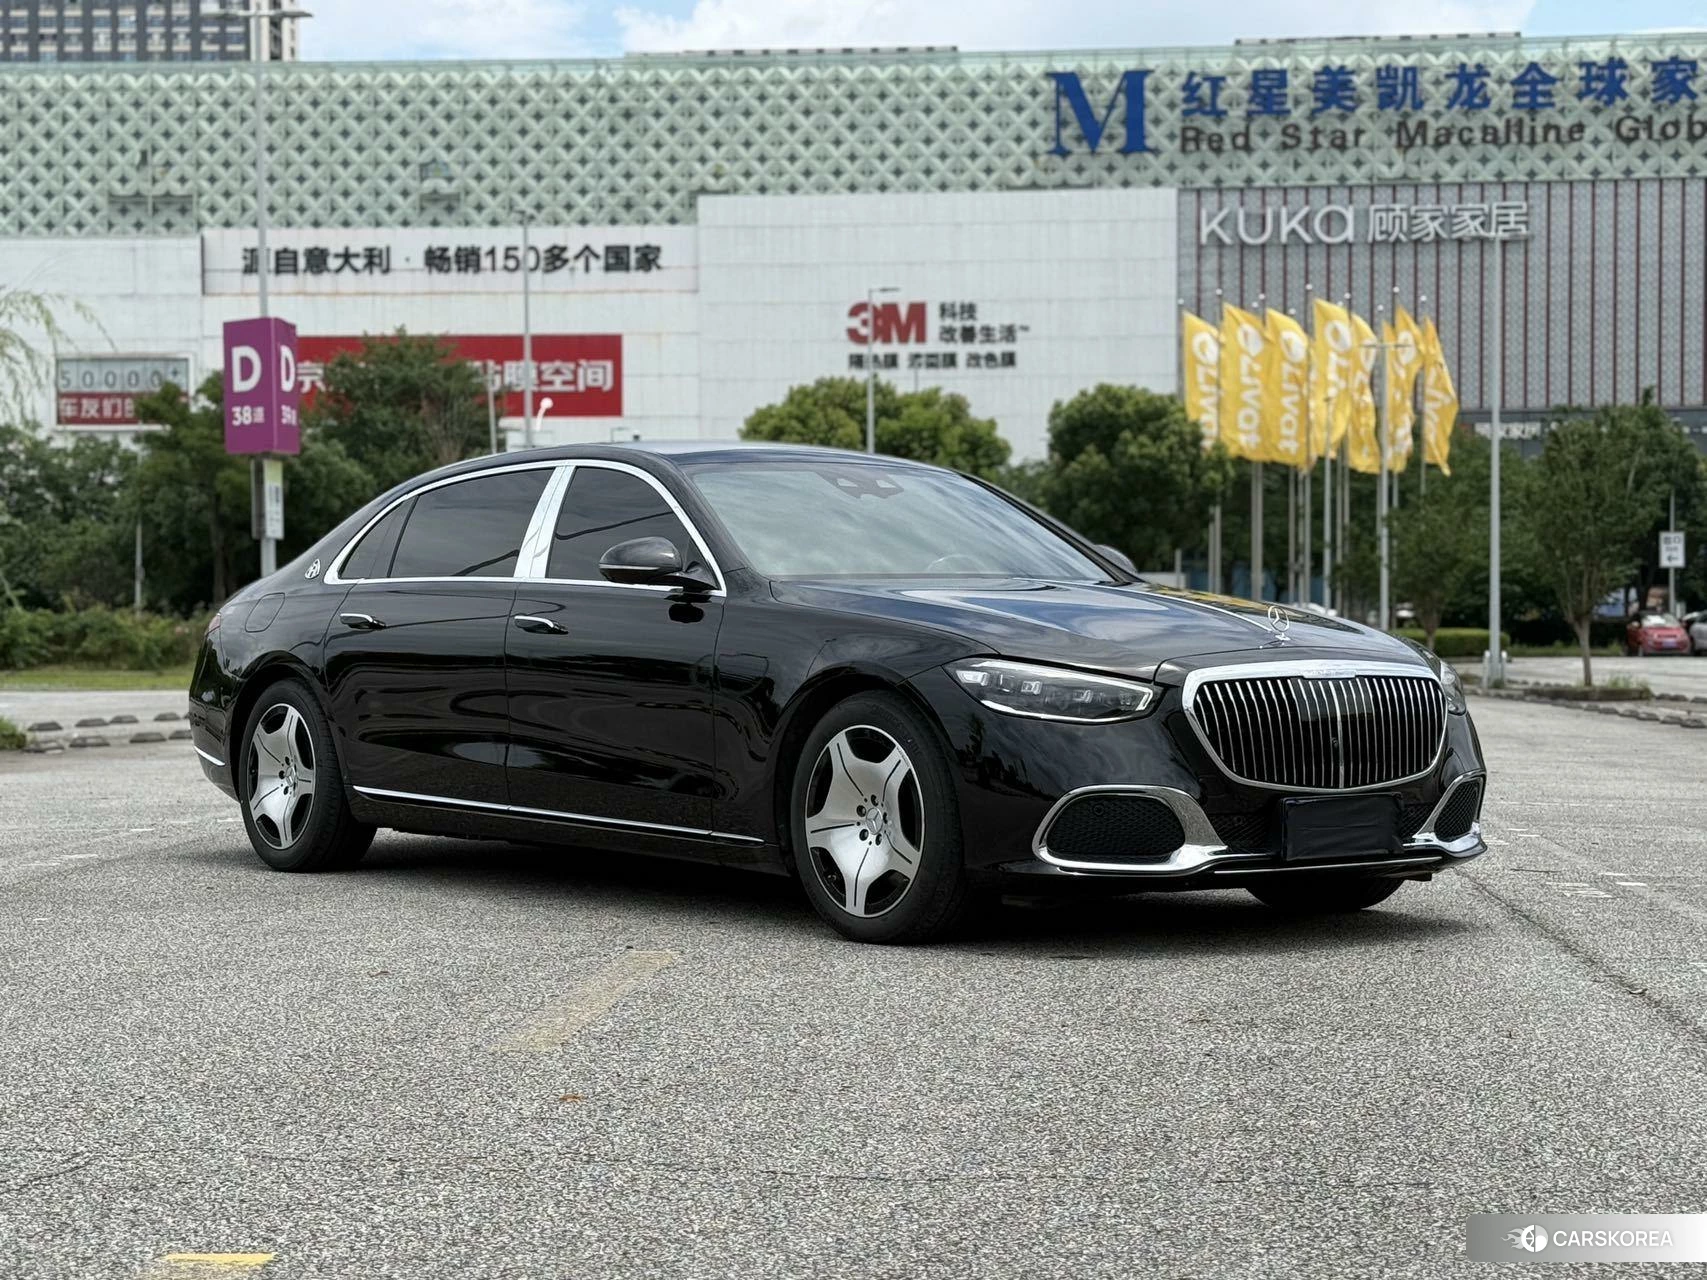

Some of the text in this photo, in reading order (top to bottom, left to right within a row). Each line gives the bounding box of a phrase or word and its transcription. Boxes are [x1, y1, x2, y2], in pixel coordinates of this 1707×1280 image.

[1181, 56, 1699, 117] 红星美凯龙全球家
[1044, 69, 1156, 156] M
[1181, 124, 1250, 151] Red
[1281, 122, 1365, 150] Star
[1397, 116, 1586, 149] Macalline
[1367, 200, 1529, 243] 顾家家居
[424, 244, 662, 274] 畅销150多个国家
[846, 302, 927, 346] 3M
[939, 301, 977, 321] 科技
[232, 344, 296, 393] D D
